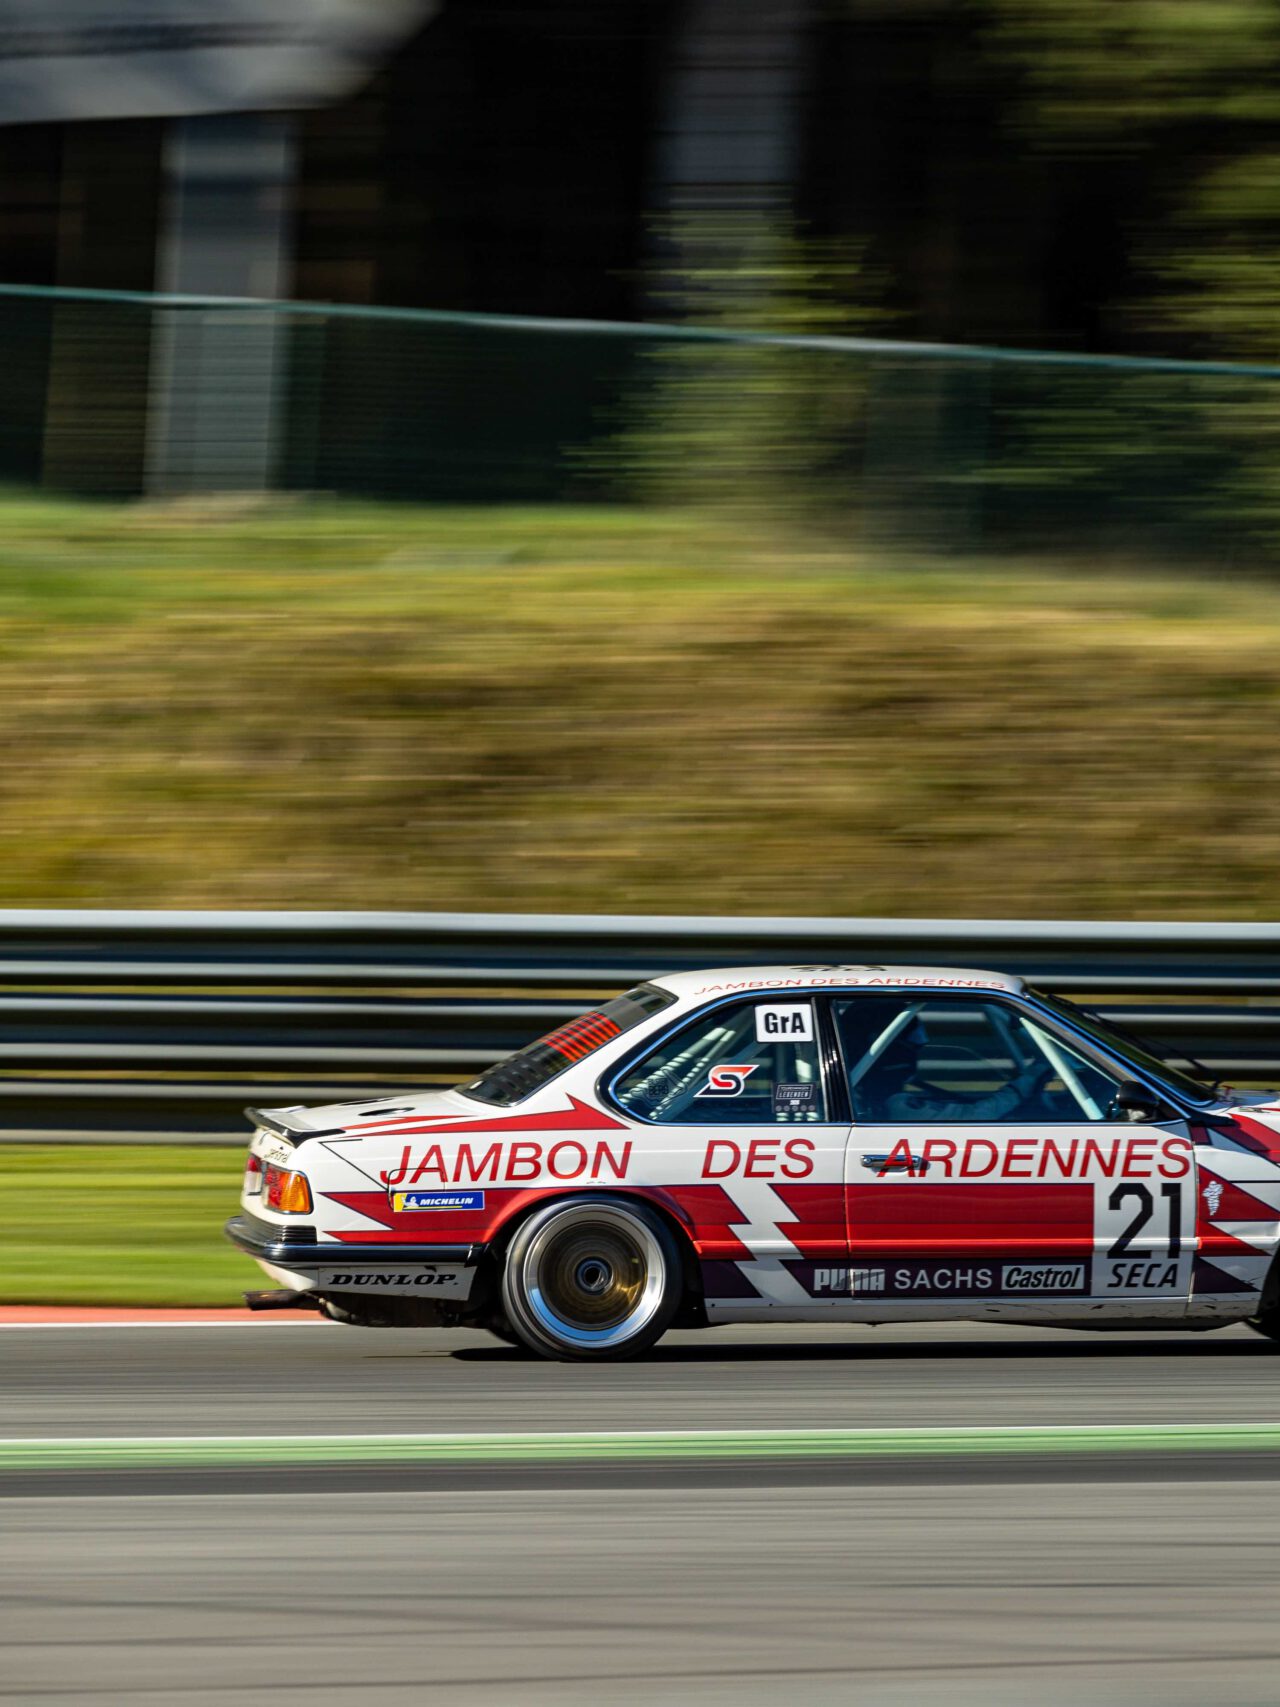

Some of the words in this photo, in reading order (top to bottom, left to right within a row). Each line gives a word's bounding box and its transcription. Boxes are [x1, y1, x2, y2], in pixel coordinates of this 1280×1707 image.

[694, 979, 802, 995] JAMBON
[811, 978, 859, 986] DES
[867, 978, 1006, 989] ARDENNES
[764, 1012, 806, 1034] GrA
[380, 1140, 633, 1185] JAMBON
[700, 1138, 816, 1179] DES
[876, 1137, 1193, 1179] ARDENNES
[420, 1197, 473, 1206] MICHELIN
[1107, 1182, 1181, 1259] 21
[813, 1268, 886, 1291] PUMA
[894, 1268, 993, 1290] SACHS
[1005, 1266, 1082, 1289] Castrol
[1107, 1263, 1179, 1288] SECA
